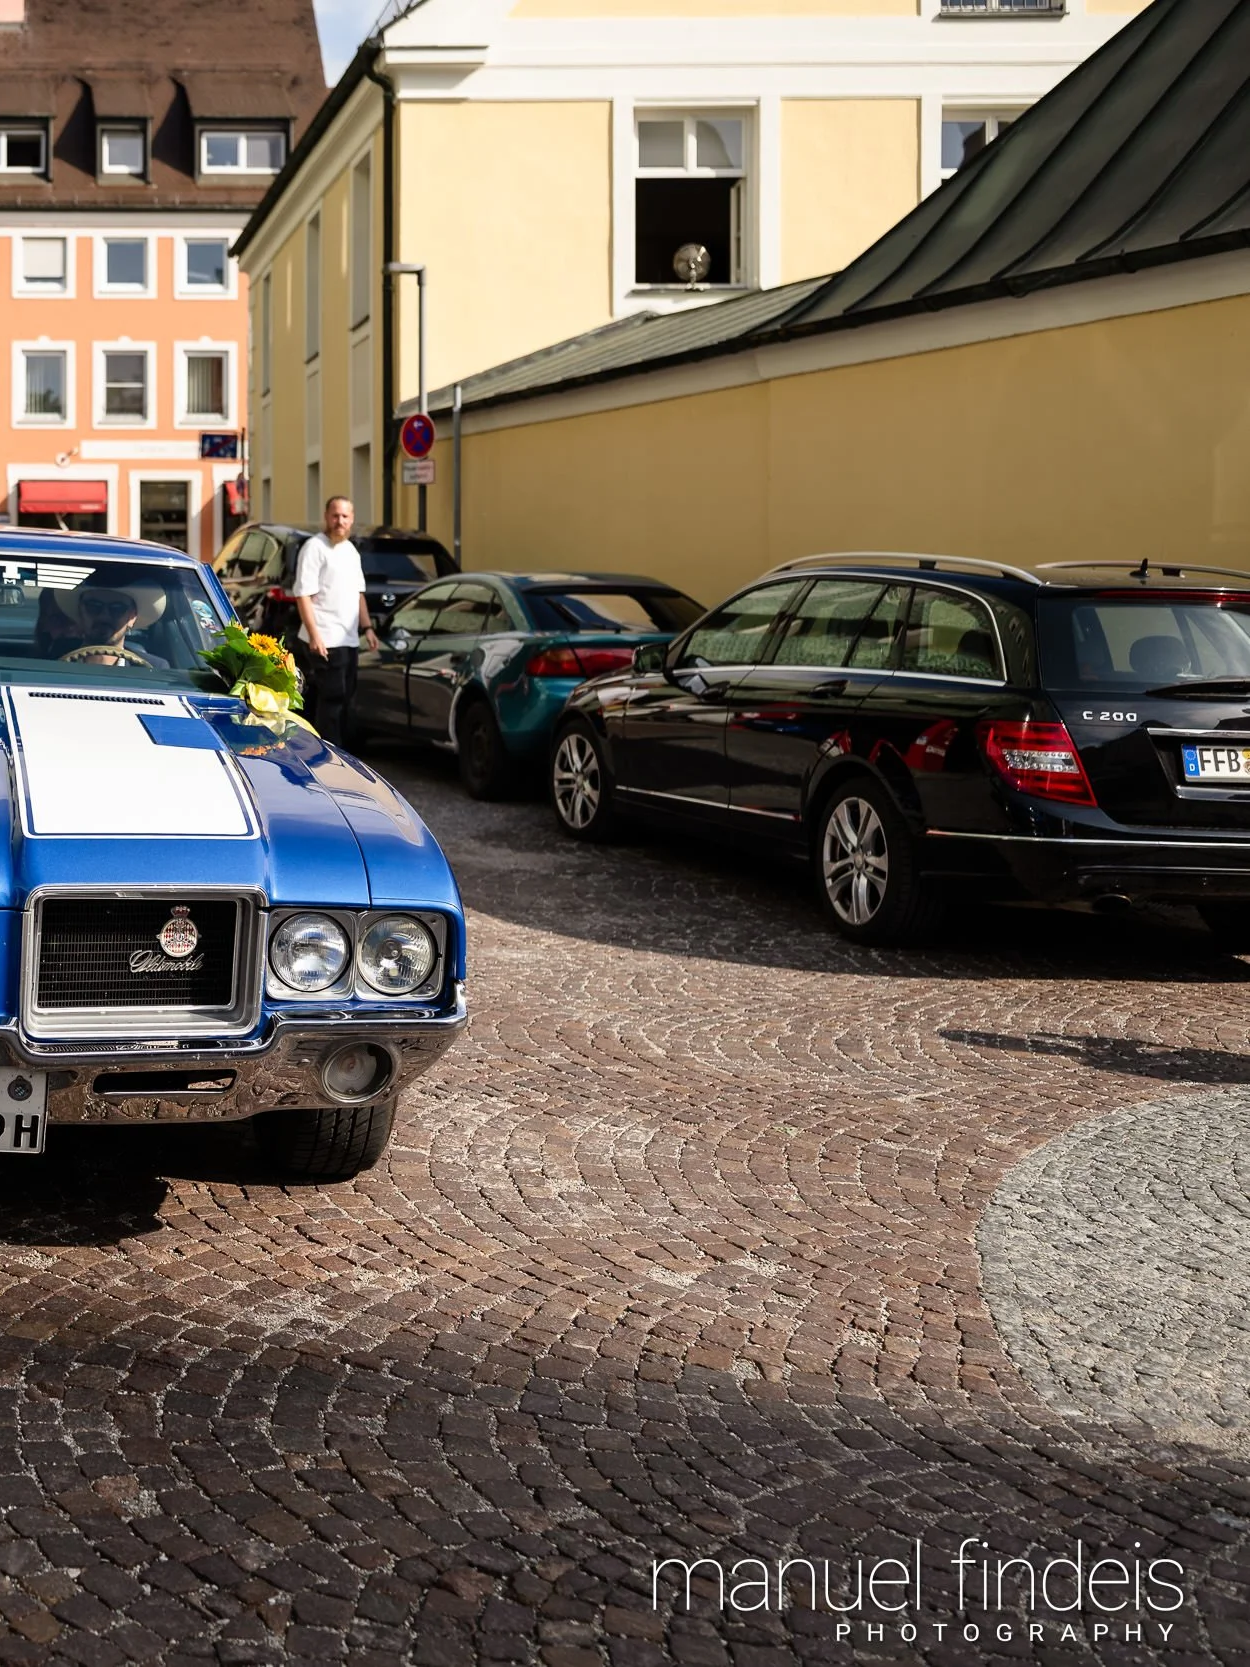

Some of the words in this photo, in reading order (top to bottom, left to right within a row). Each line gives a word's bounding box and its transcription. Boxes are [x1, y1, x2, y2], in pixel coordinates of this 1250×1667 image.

[1082, 711, 1093, 720] C
[1100, 711, 1137, 721] 200
[1189, 763, 1196, 771] D
[1198, 748, 1241, 772] FFB
[129, 949, 205, 973] Oldsmobile
